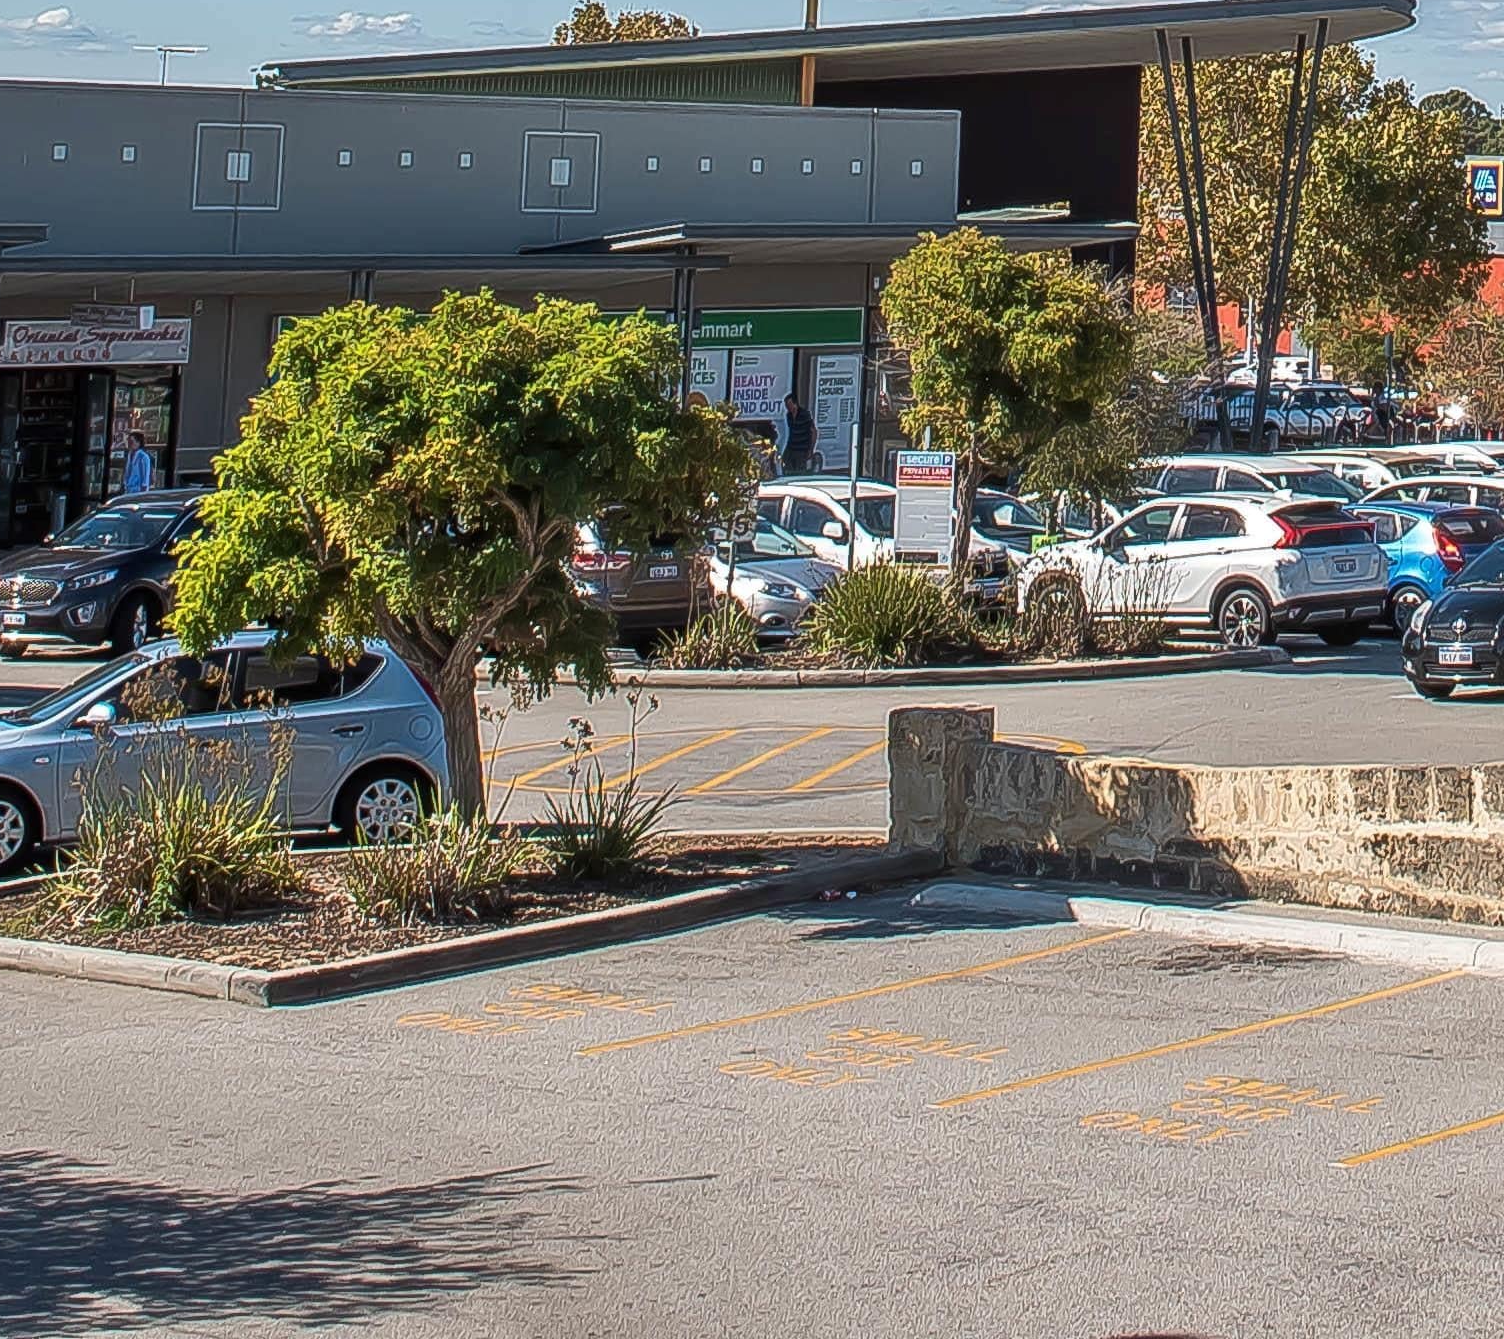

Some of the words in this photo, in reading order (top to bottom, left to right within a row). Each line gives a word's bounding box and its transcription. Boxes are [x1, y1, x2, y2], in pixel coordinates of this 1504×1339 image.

[13, 325, 80, 344] Oriental
[80, 324, 185, 350] Supermarket
[734, 375, 775, 388] BEAUTY
[733, 389, 768, 400] INSIDE
[759, 401, 783, 412] OUT
